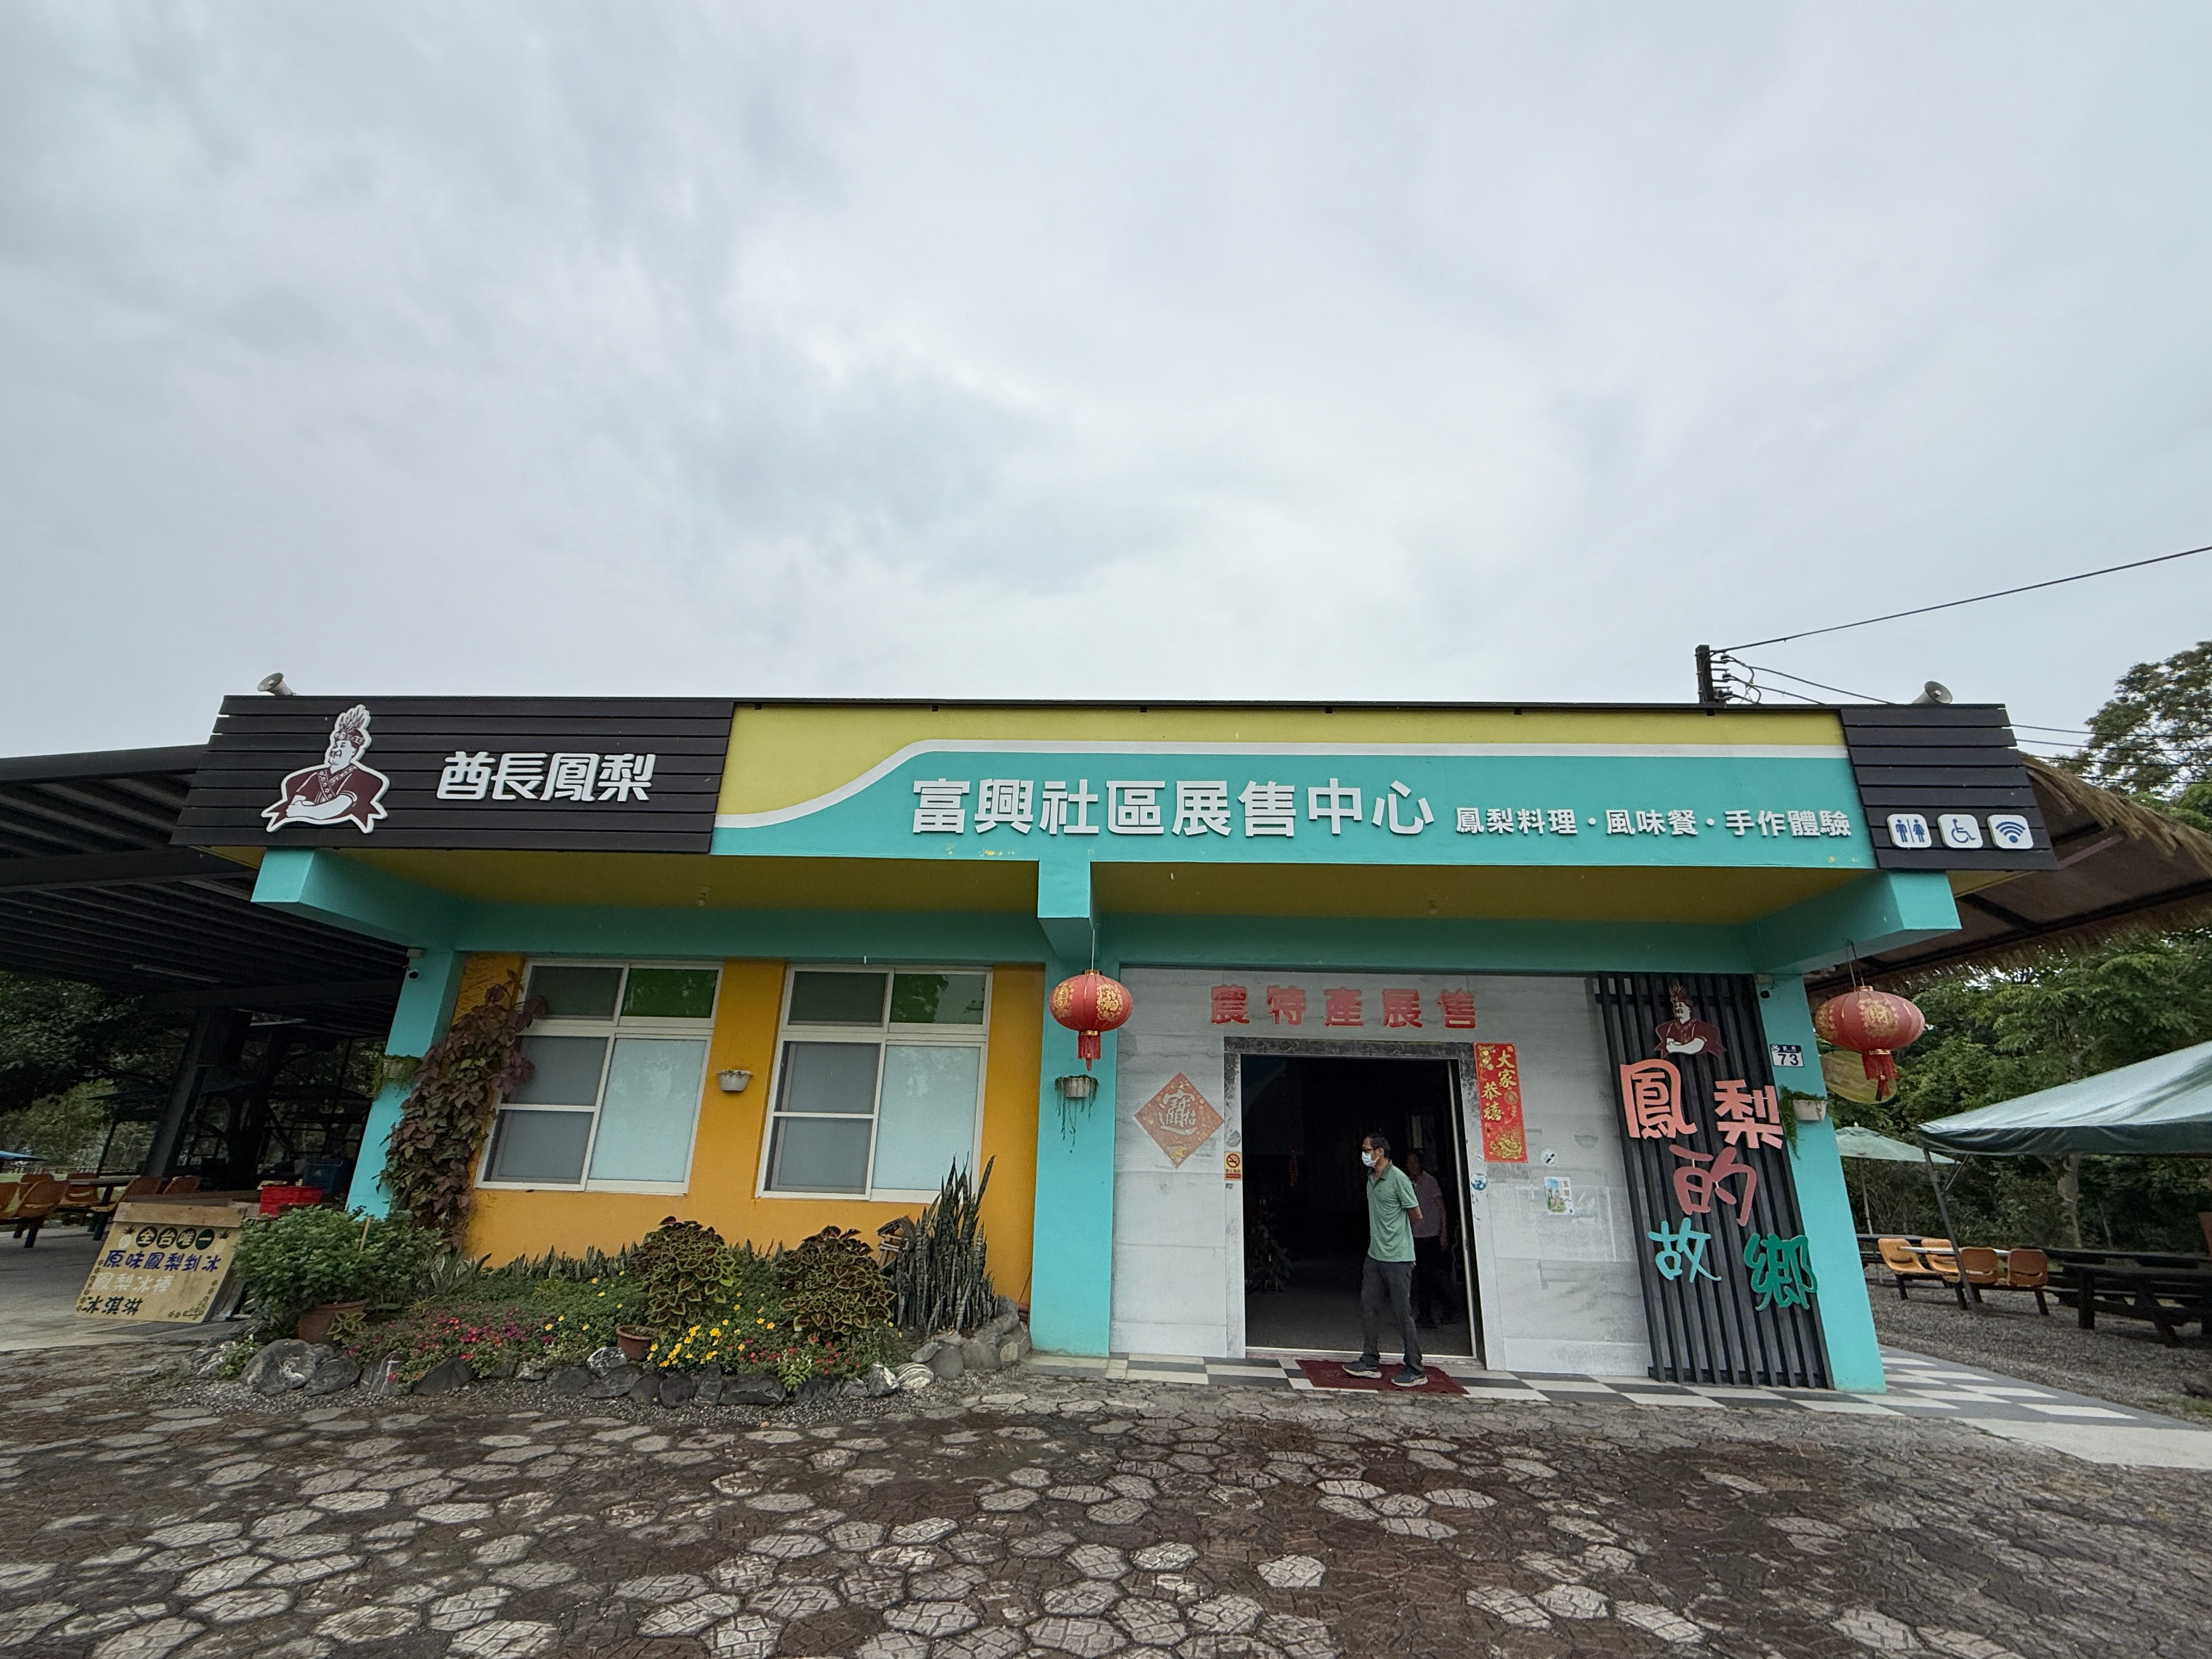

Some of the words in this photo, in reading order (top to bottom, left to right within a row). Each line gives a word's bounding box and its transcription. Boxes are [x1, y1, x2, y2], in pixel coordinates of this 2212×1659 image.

[437, 751, 656, 803] 酋長鳳梨
[912, 777, 1435, 838] 富興社區展售中心
[1210, 984, 1476, 1029] 農特產展售
[1496, 1049, 1517, 1088] 大家
[1778, 1053, 1799, 1065] 73
[1620, 1059, 1784, 1149] 鳳梨
[1668, 1144, 1756, 1227] 的
[137, 1227, 213, 1249] 全台唯一
[82, 1295, 143, 1316] 冰淇淋
